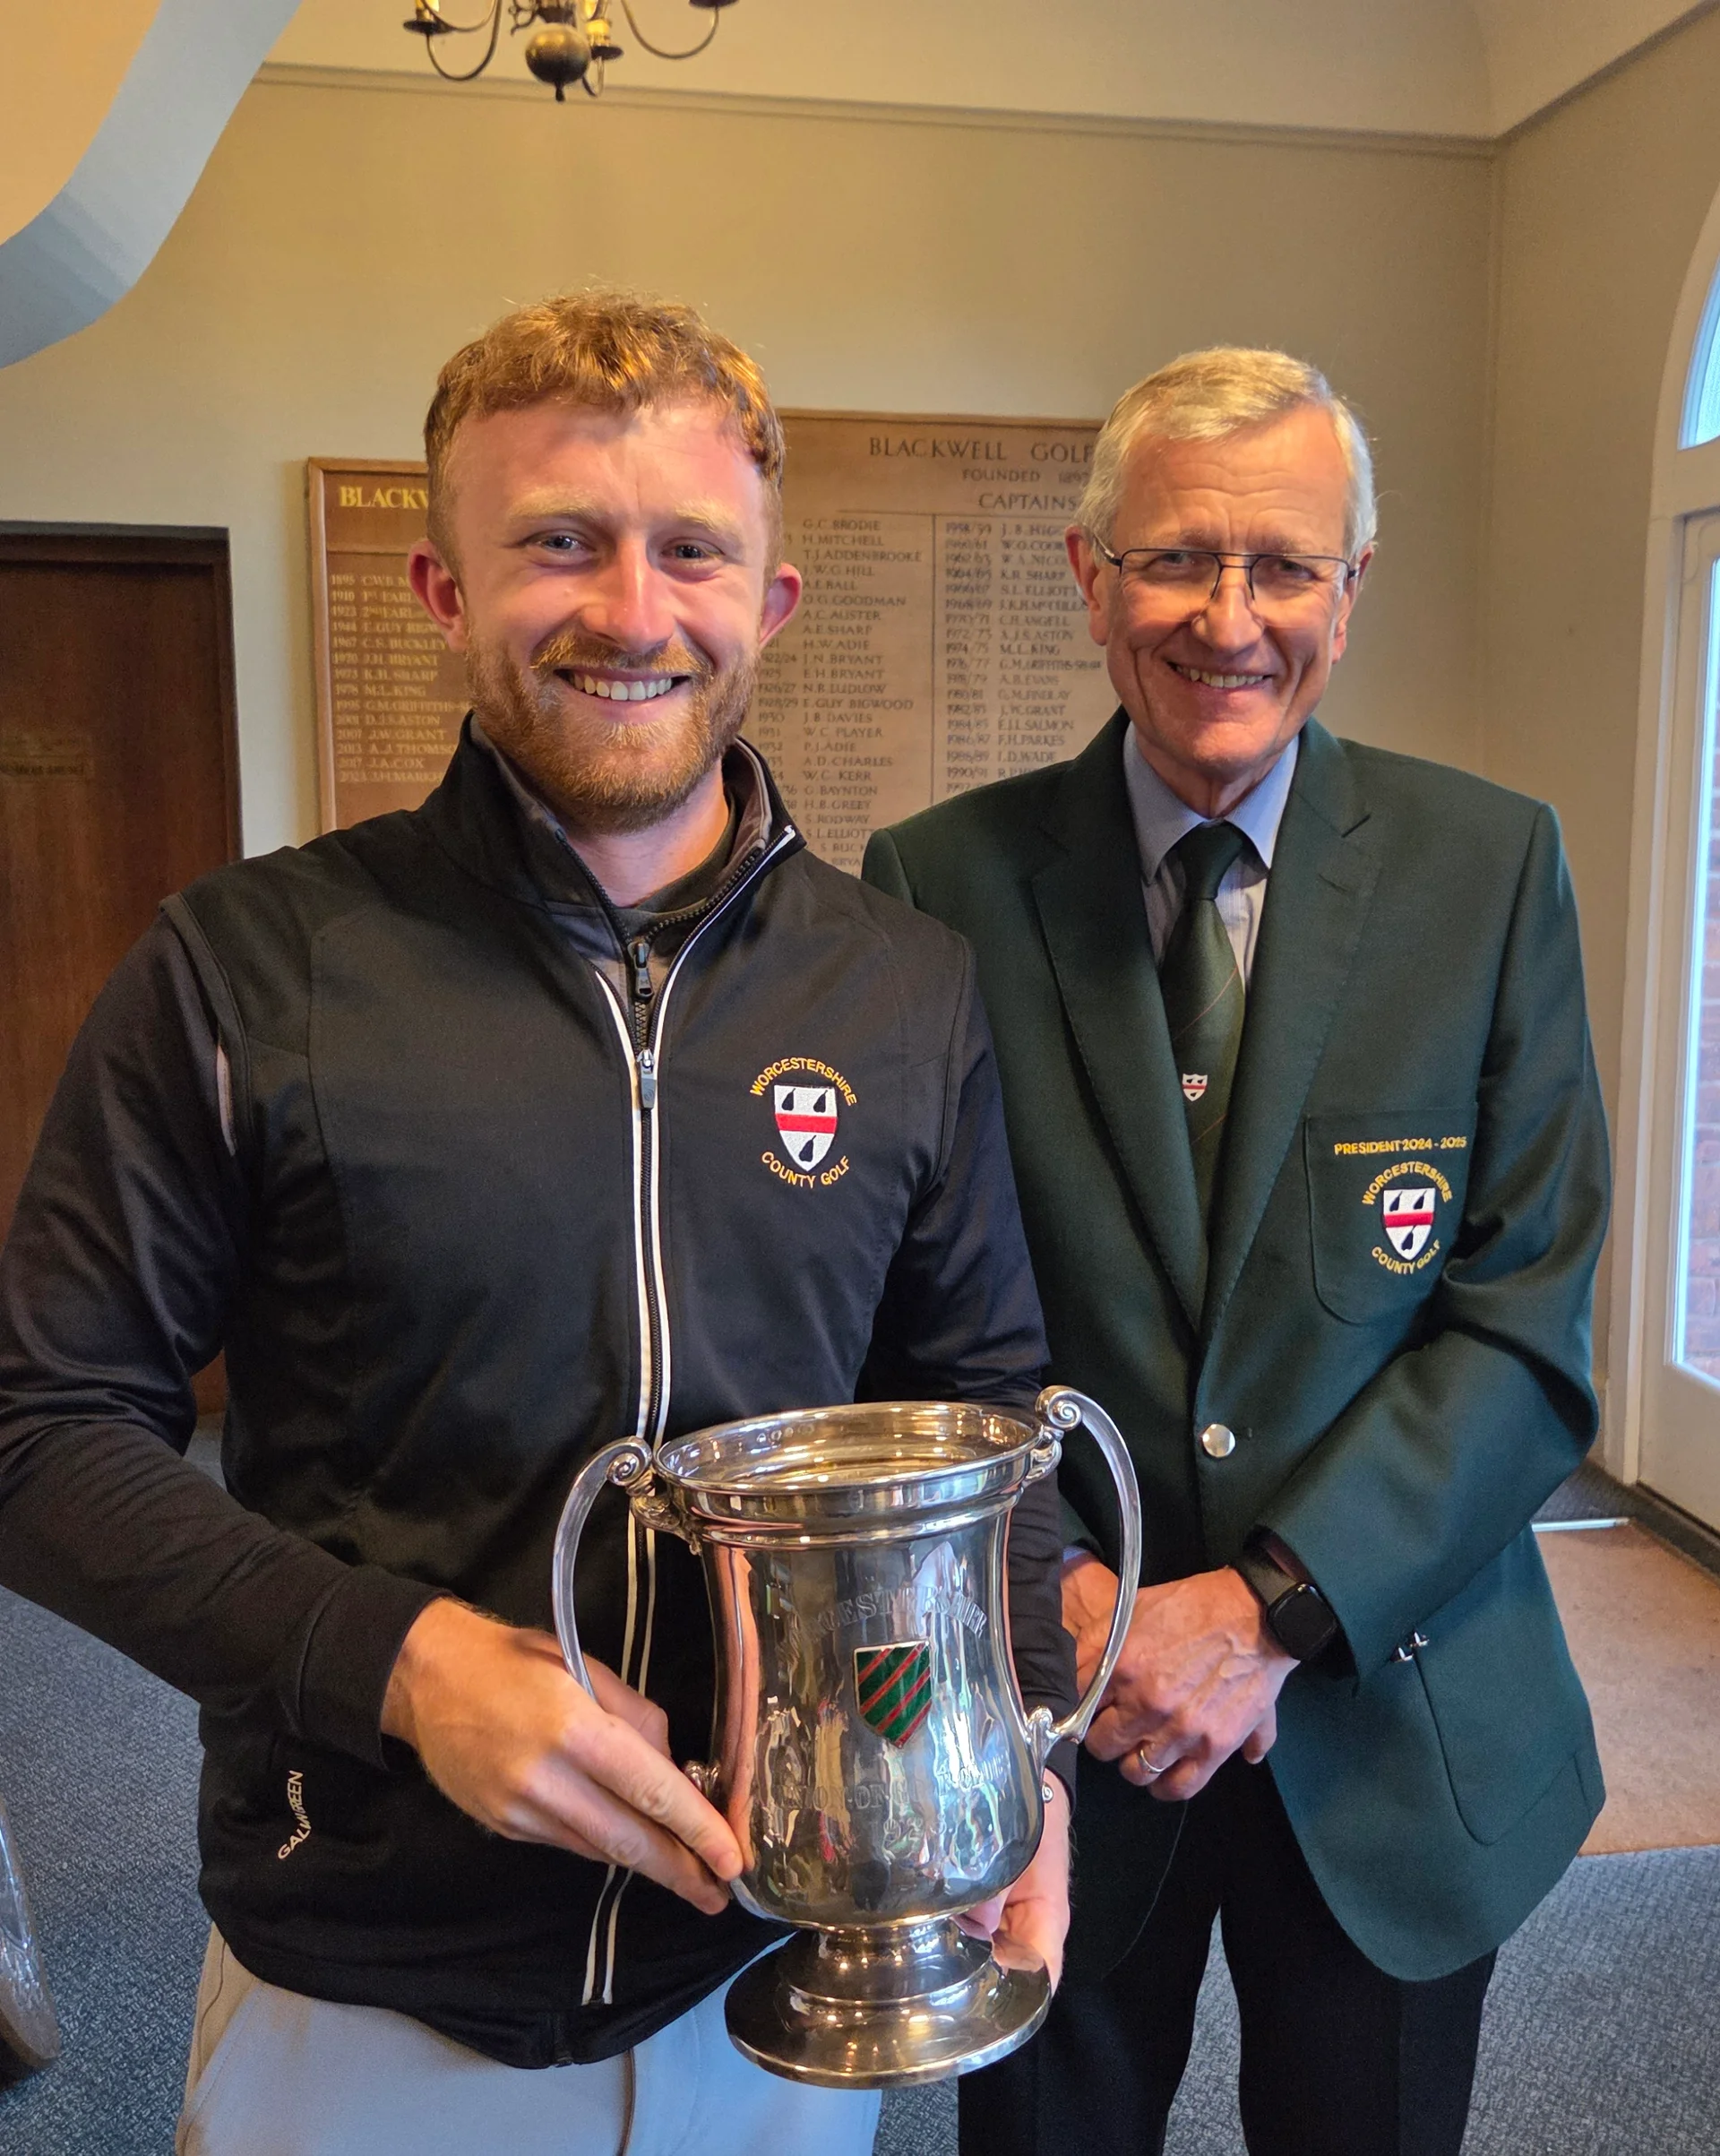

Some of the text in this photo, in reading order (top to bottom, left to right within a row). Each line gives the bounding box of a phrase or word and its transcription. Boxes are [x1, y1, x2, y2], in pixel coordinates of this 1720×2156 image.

[869, 437, 1009, 461] BLACKWELL
[963, 468, 1041, 483] FOUNDED
[978, 493, 1077, 511] CAPTAINS
[831, 596, 907, 607] GOODMAN
[830, 654, 885, 666] BRYANT
[830, 669, 886, 680] BRYANT
[835, 728, 884, 737] PLAYER
[830, 757, 893, 767] CHARLES
[749, 1056, 858, 1108] WORCESTERSHIRE
[1334, 1140, 1403, 1156] PRESIDENT
[1401, 1138, 1432, 1152] 2024
[1440, 1135, 1467, 1150] 2025
[761, 1151, 851, 1189] COUNTY GOLF
[1361, 1160, 1453, 1206] WORCESTERSHIRE
[1371, 1238, 1441, 1275] COUNTY GOLF
